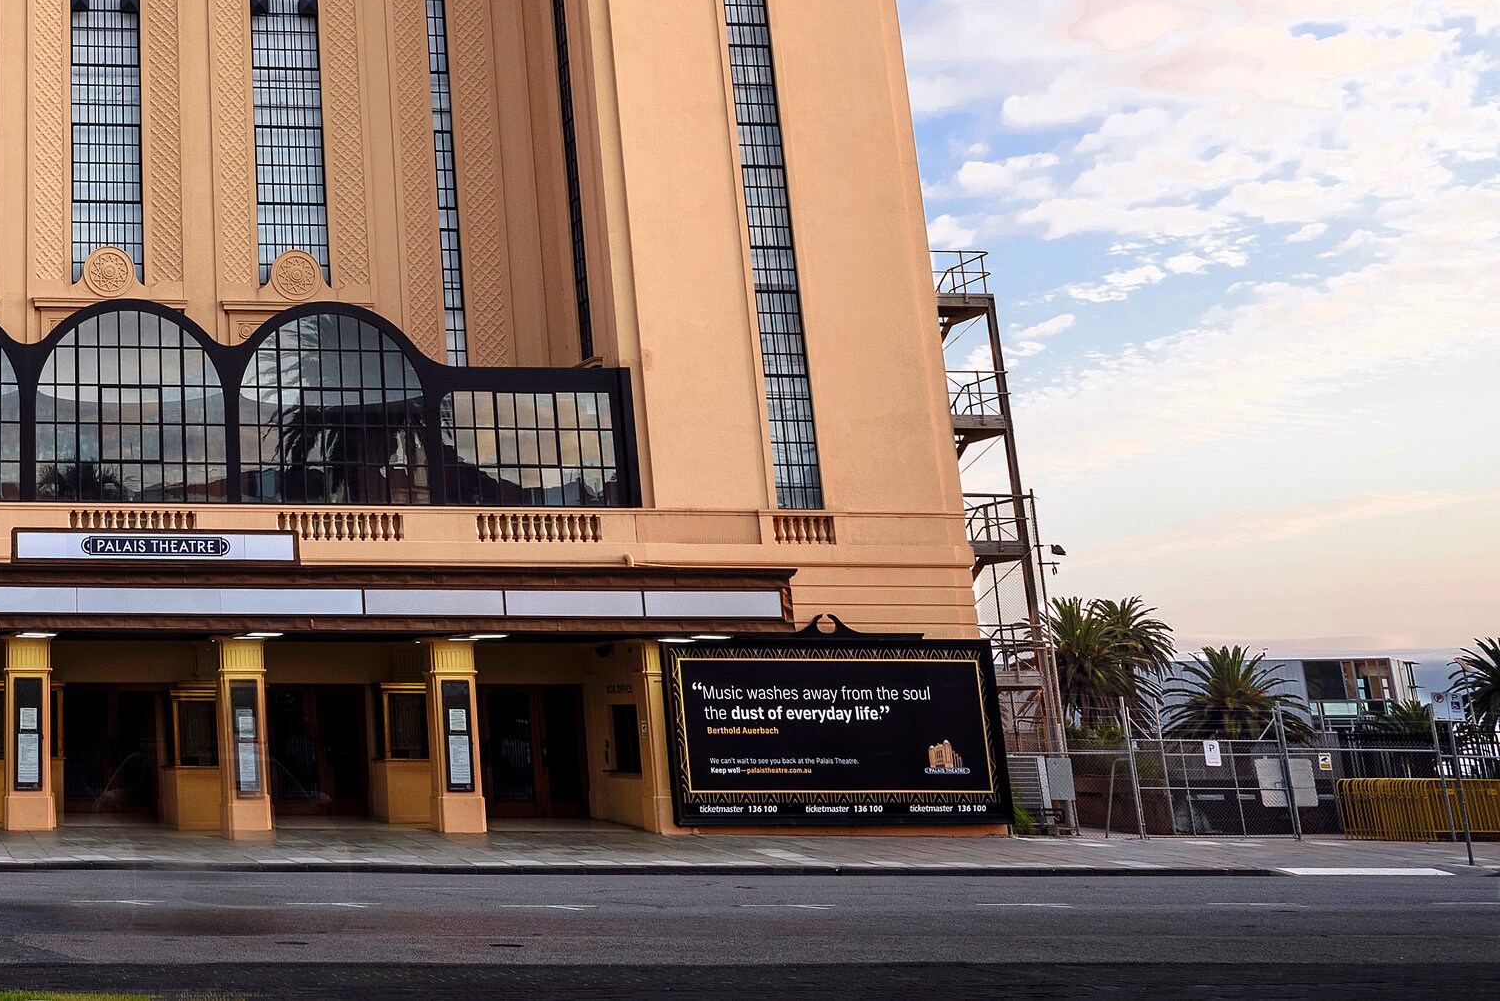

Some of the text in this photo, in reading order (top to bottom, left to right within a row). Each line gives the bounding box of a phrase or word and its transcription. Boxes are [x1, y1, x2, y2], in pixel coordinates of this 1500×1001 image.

[97, 539, 215, 553] PALAIS THEATRE
[747, 685, 799, 700] washes
[803, 688, 837, 703] away
[840, 685, 873, 700] from
[876, 685, 899, 700] the
[902, 685, 931, 701] soul
[704, 705, 727, 720] the
[731, 705, 765, 720] dust
[767, 705, 783, 720] of
[786, 705, 852, 724] everyday
[707, 726, 779, 735] Berthold Auerbach
[769, 758, 781, 766] you
[816, 757, 834, 765] Palais
[834, 757, 860, 765] Theatre.
[710, 766, 727, 776] Keep
[699, 804, 778, 813] ticketmaster 136 100
[805, 804, 884, 813] ticketmaster 136 100
[909, 804, 987, 813] ticketmaster 136 100
